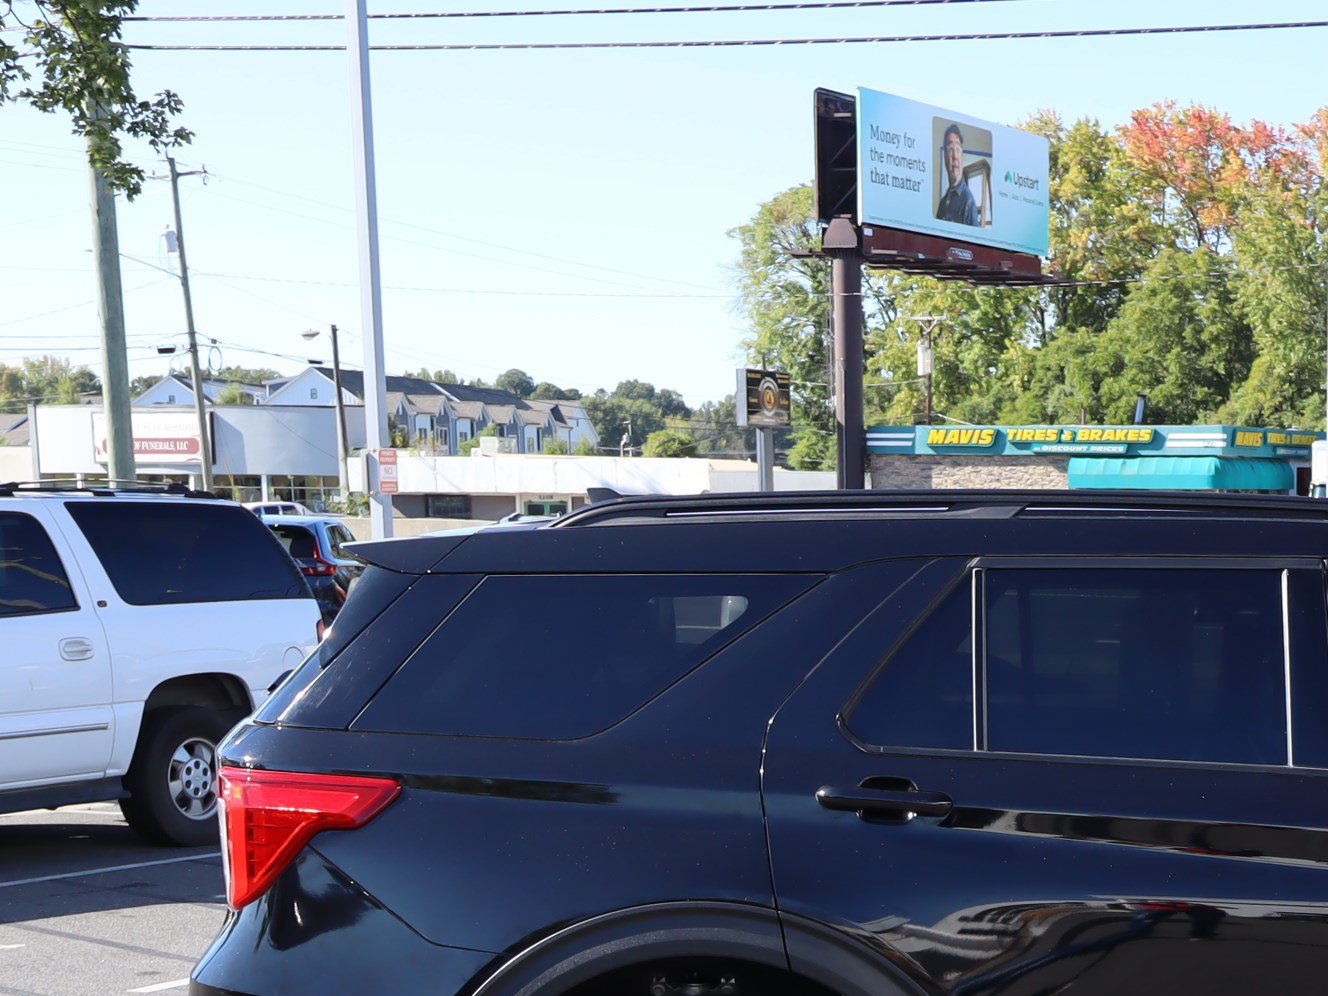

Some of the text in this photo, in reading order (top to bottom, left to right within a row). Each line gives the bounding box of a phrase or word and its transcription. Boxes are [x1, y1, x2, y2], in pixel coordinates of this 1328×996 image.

[870, 123, 916, 149] Money for
[870, 146, 926, 173] the moments
[870, 167, 890, 186] that
[1013, 171, 1040, 191] Upstart
[176, 441, 189, 451] LLC
[927, 428, 1153, 446] MAVIS TIRES & BRAKES
